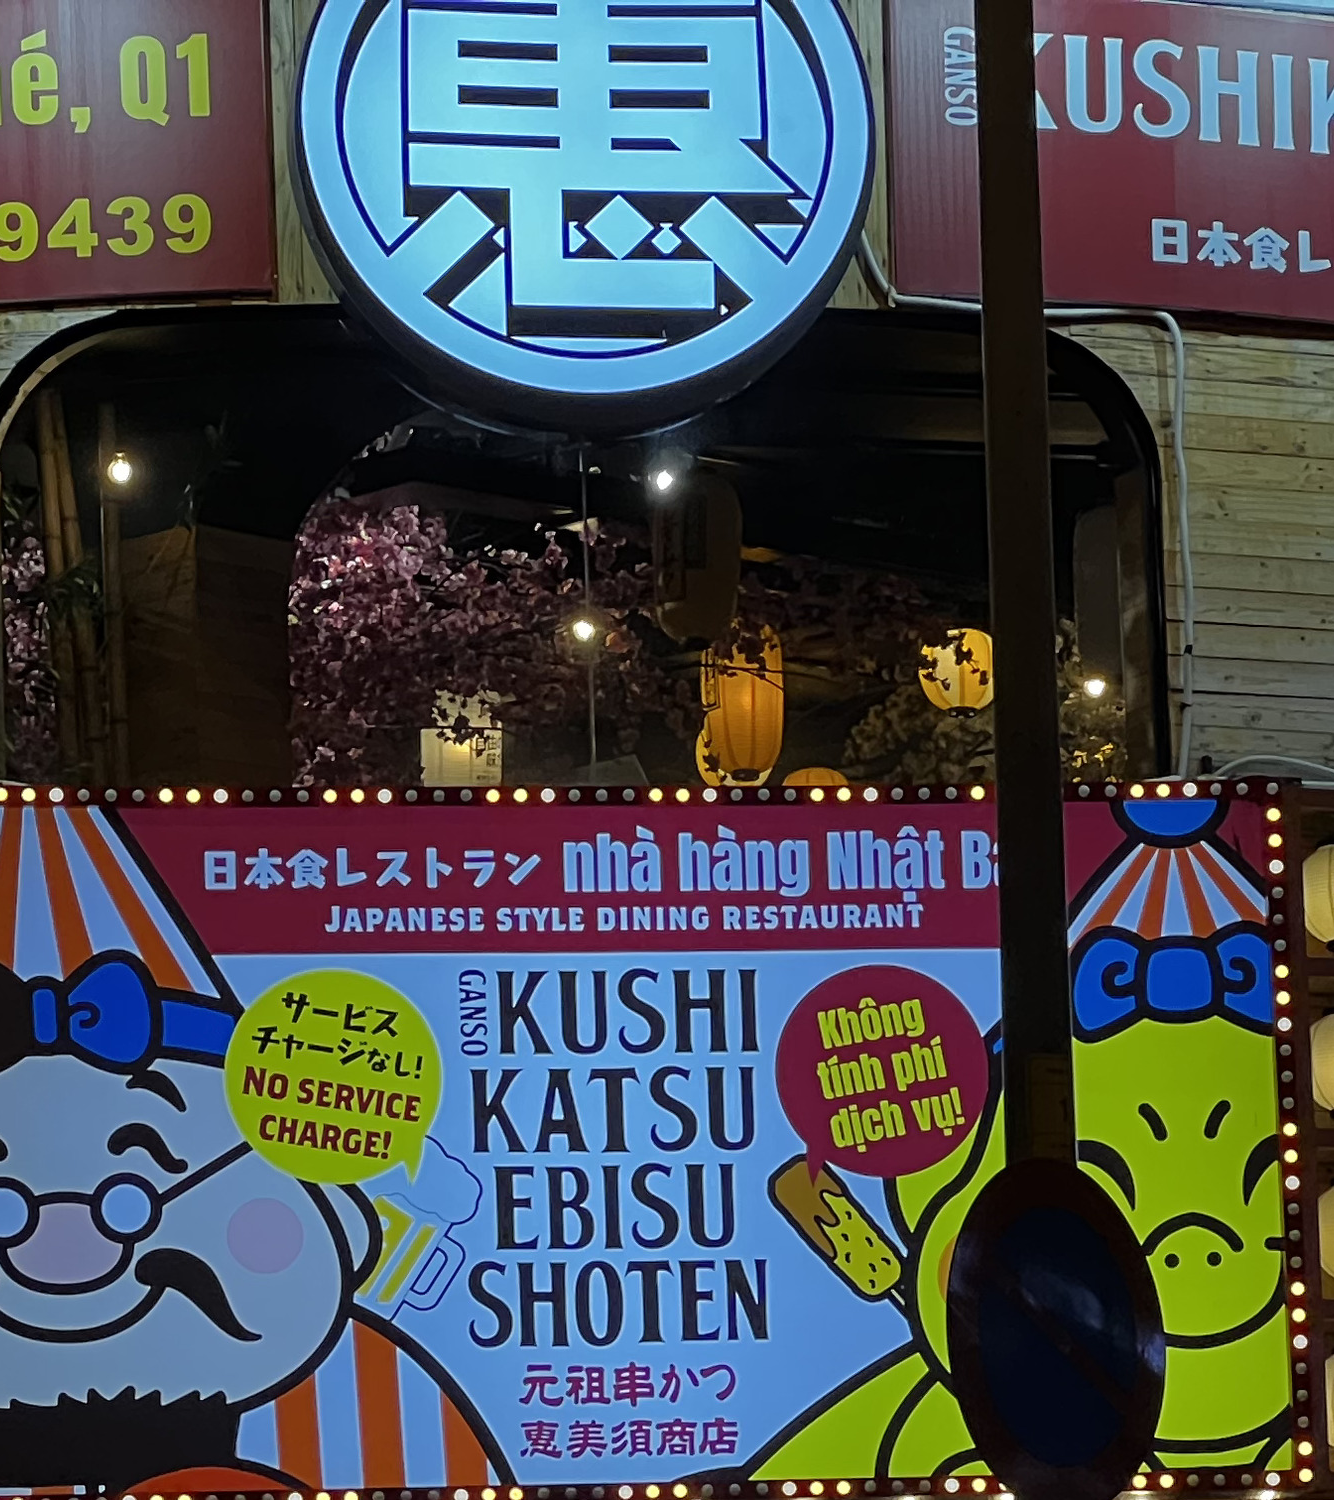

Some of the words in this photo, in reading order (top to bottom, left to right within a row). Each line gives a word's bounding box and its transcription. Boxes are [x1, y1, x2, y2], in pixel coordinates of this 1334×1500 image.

[119, 33, 211, 127] Q1
[944, 26, 978, 127] GANSO
[204, 848, 541, 891] 日本食レストラン
[563, 825, 661, 893] nhà
[677, 825, 810, 897] hàng
[827, 826, 945, 902] Nhật
[324, 905, 486, 934] JAPANESE
[496, 906, 584, 933] STYLE
[597, 904, 711, 932] DINING
[723, 902, 924, 931] RESTAURANT
[282, 991, 399, 1039] サービス
[459, 969, 489, 1057] GANSO
[497, 968, 759, 1056] KUSHI
[817, 997, 926, 1050] Không
[242, 1066, 292, 1100] NO
[297, 1074, 422, 1123] SERVICE
[817, 1053, 886, 1100] tính
[891, 1036, 947, 1091] phí
[258, 1113, 392, 1161] CHARGE!
[469, 1066, 756, 1154] KATSU
[830, 1100, 906, 1153] dịch
[910, 1087, 966, 1137] vụ!
[495, 1163, 735, 1250] EBISU
[468, 1258, 771, 1349] SHOTEN
[520, 1362, 737, 1407] 元祖串かつ
